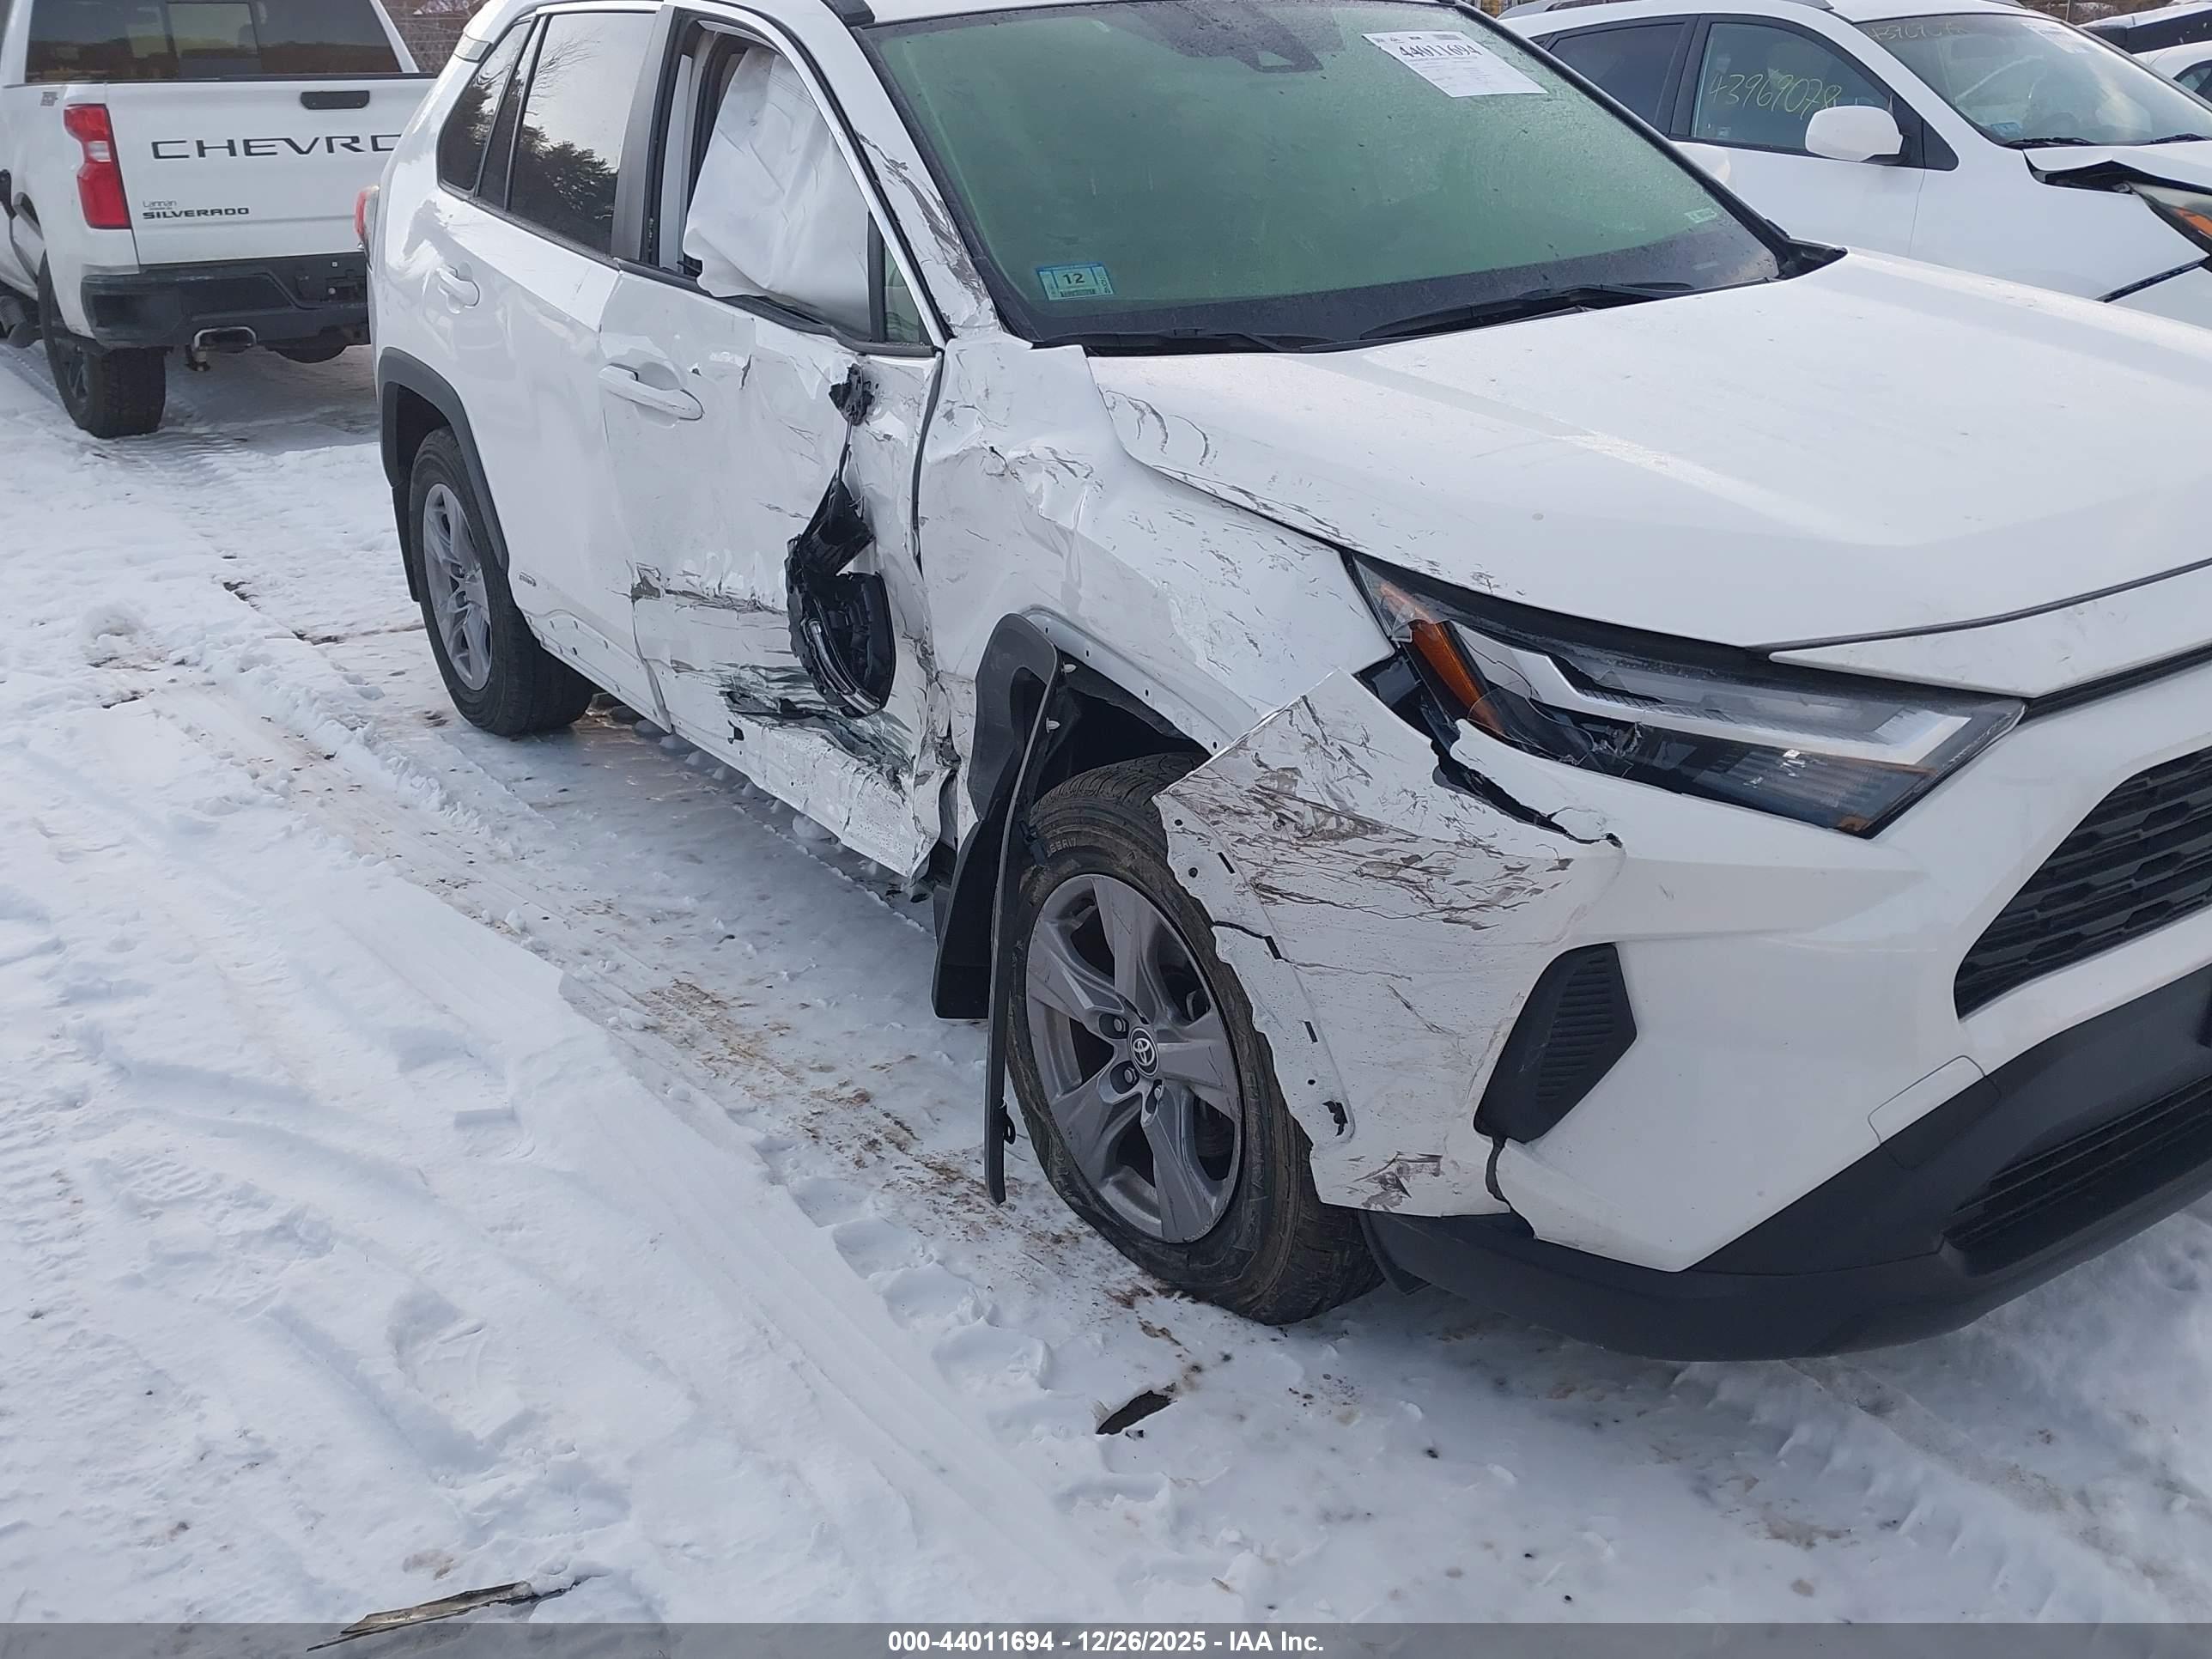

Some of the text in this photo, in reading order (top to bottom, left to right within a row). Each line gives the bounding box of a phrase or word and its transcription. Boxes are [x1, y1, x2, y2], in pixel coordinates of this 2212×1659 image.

[1399, 44, 1483, 58] 44011694
[1709, 74, 1842, 120] 43969078
[143, 207, 250, 220] SILVERADO
[1063, 273, 1085, 284] 12
